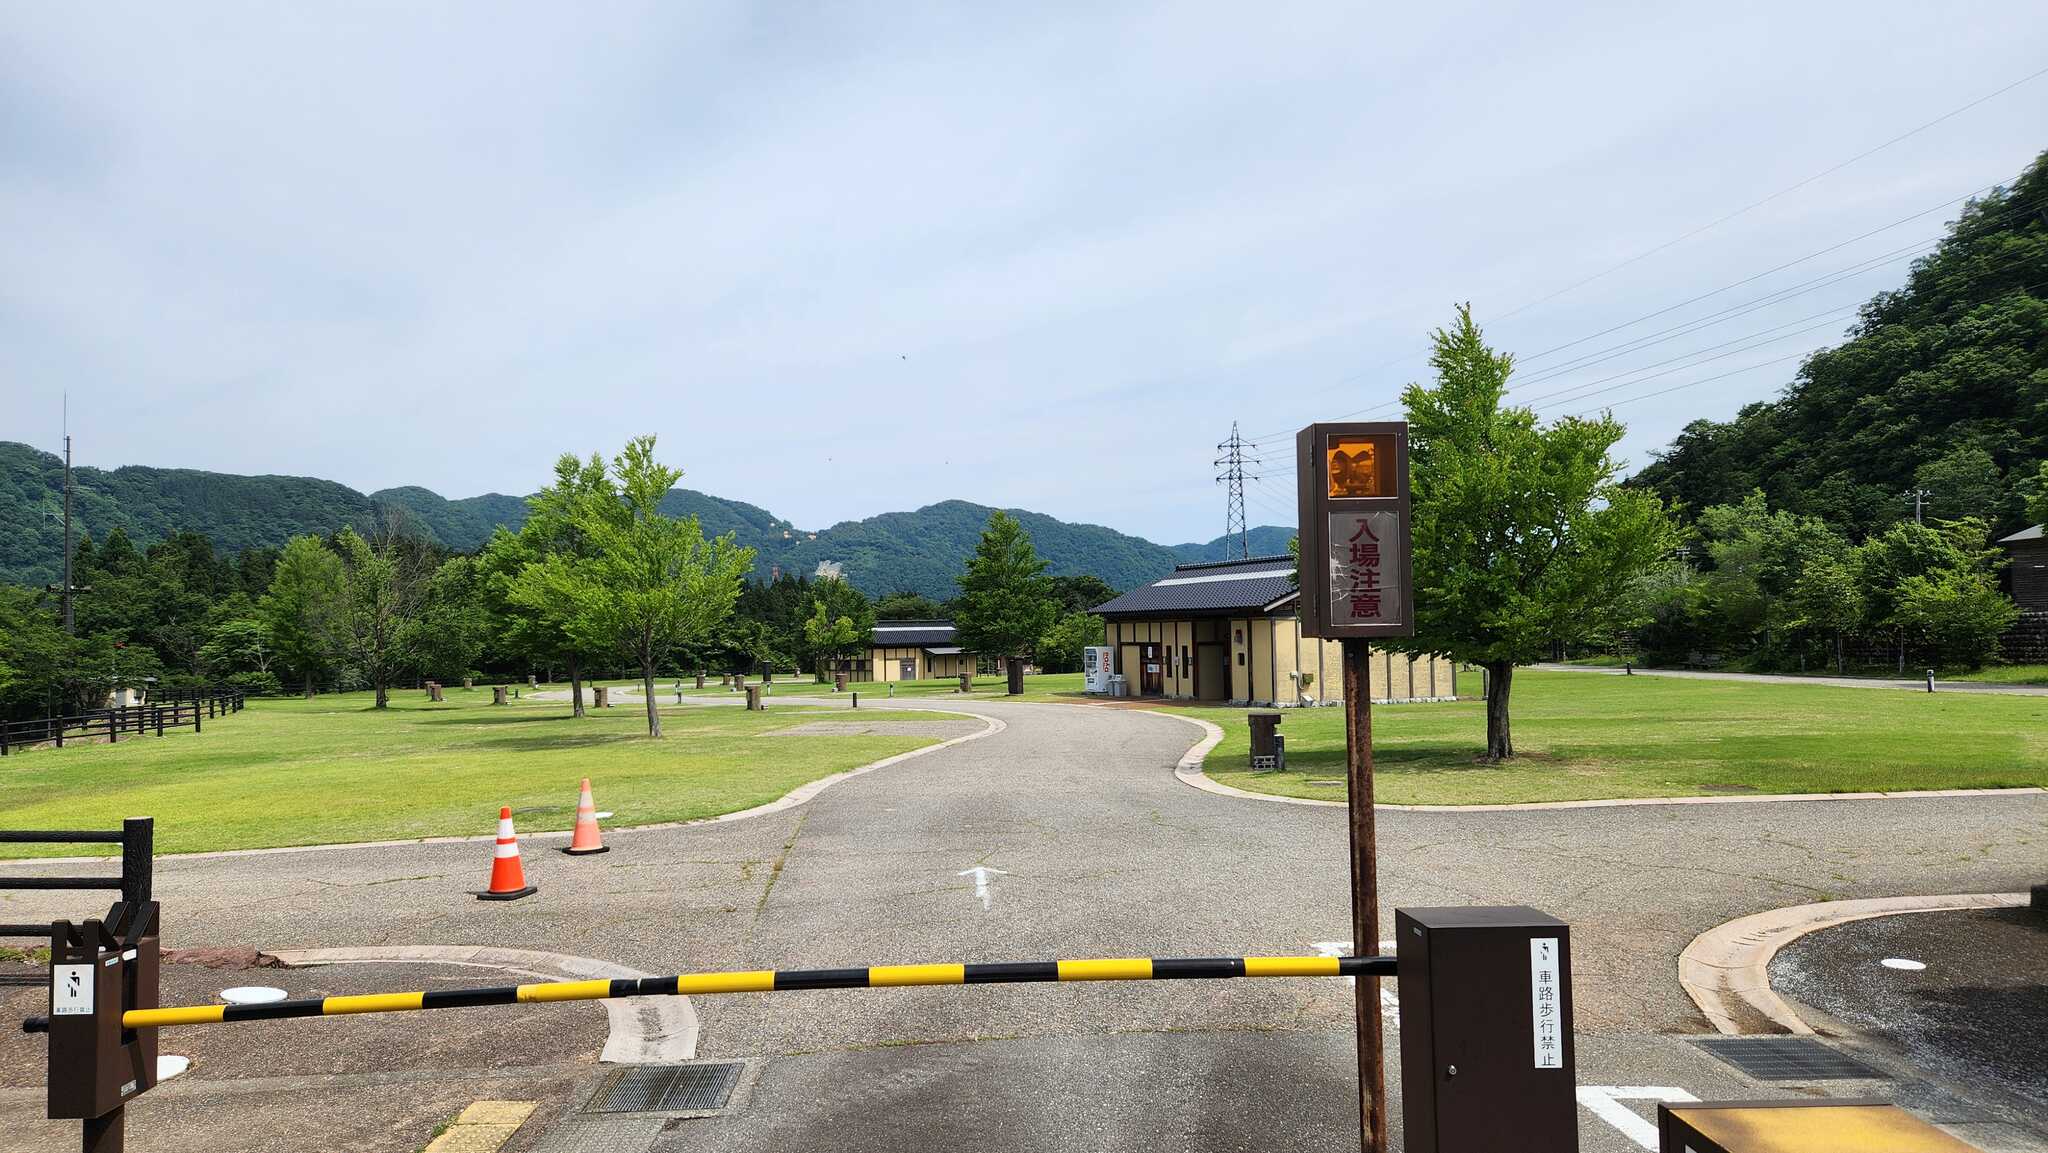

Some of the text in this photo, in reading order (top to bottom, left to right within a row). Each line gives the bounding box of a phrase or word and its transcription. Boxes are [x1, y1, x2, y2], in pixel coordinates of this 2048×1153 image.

[1349, 519, 1382, 618] 入場注意
[1538, 970, 1556, 1066] 車路歩行禁止
